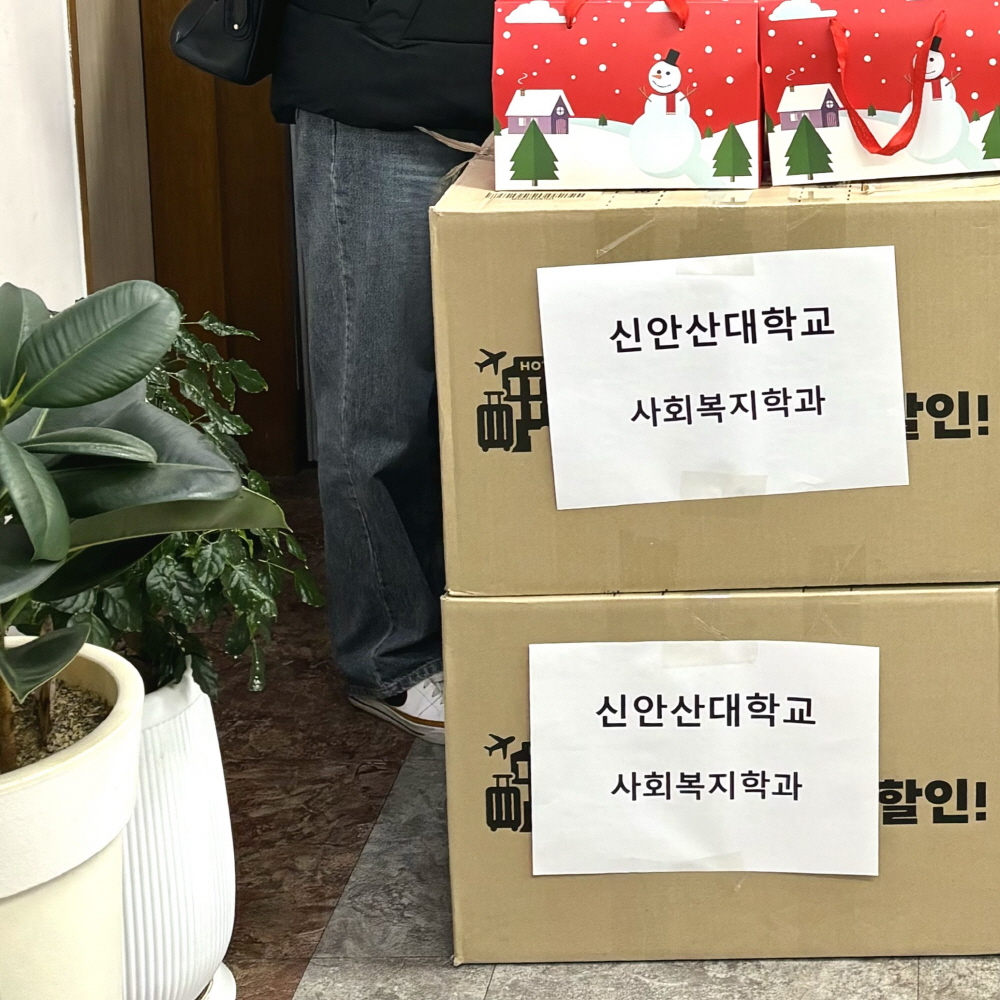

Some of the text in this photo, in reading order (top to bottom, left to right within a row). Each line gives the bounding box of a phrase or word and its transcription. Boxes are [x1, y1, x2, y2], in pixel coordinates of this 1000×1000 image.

[609, 305, 835, 354] 신안산대학교
[520, 361, 544, 371] HO
[630, 384, 826, 428] 사회복지학과
[595, 692, 817, 728] 신안산대학교
[610, 769, 803, 801] 사회복지학과
[878, 779, 986, 825] 할인!
